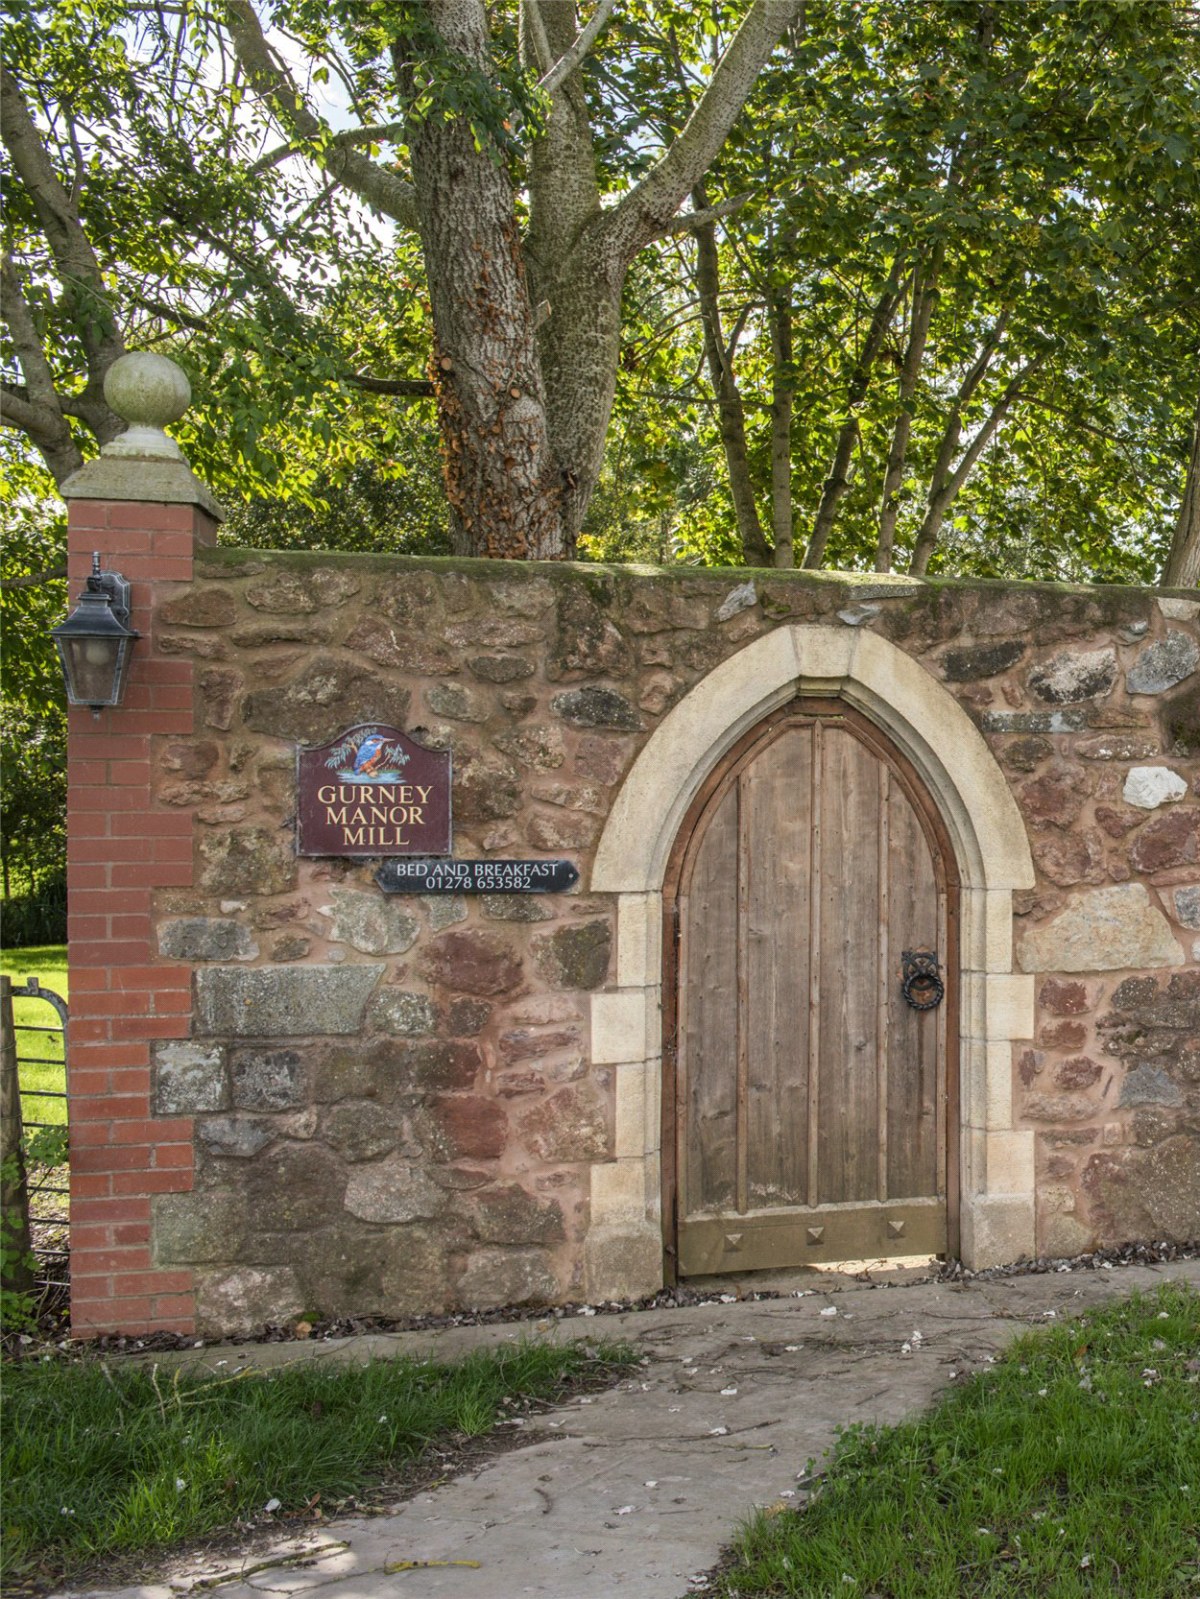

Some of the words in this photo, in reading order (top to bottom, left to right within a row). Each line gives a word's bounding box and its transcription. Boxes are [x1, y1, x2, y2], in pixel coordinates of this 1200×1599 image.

[317, 785, 434, 804] GURNEY
[325, 806, 426, 825] MANOR
[342, 826, 410, 846] MILL
[396, 863, 428, 877] BED
[431, 863, 470, 877] AND
[474, 863, 559, 877] BREAKFAST
[425, 876, 472, 889] 01278
[476, 876, 531, 890] 653582
